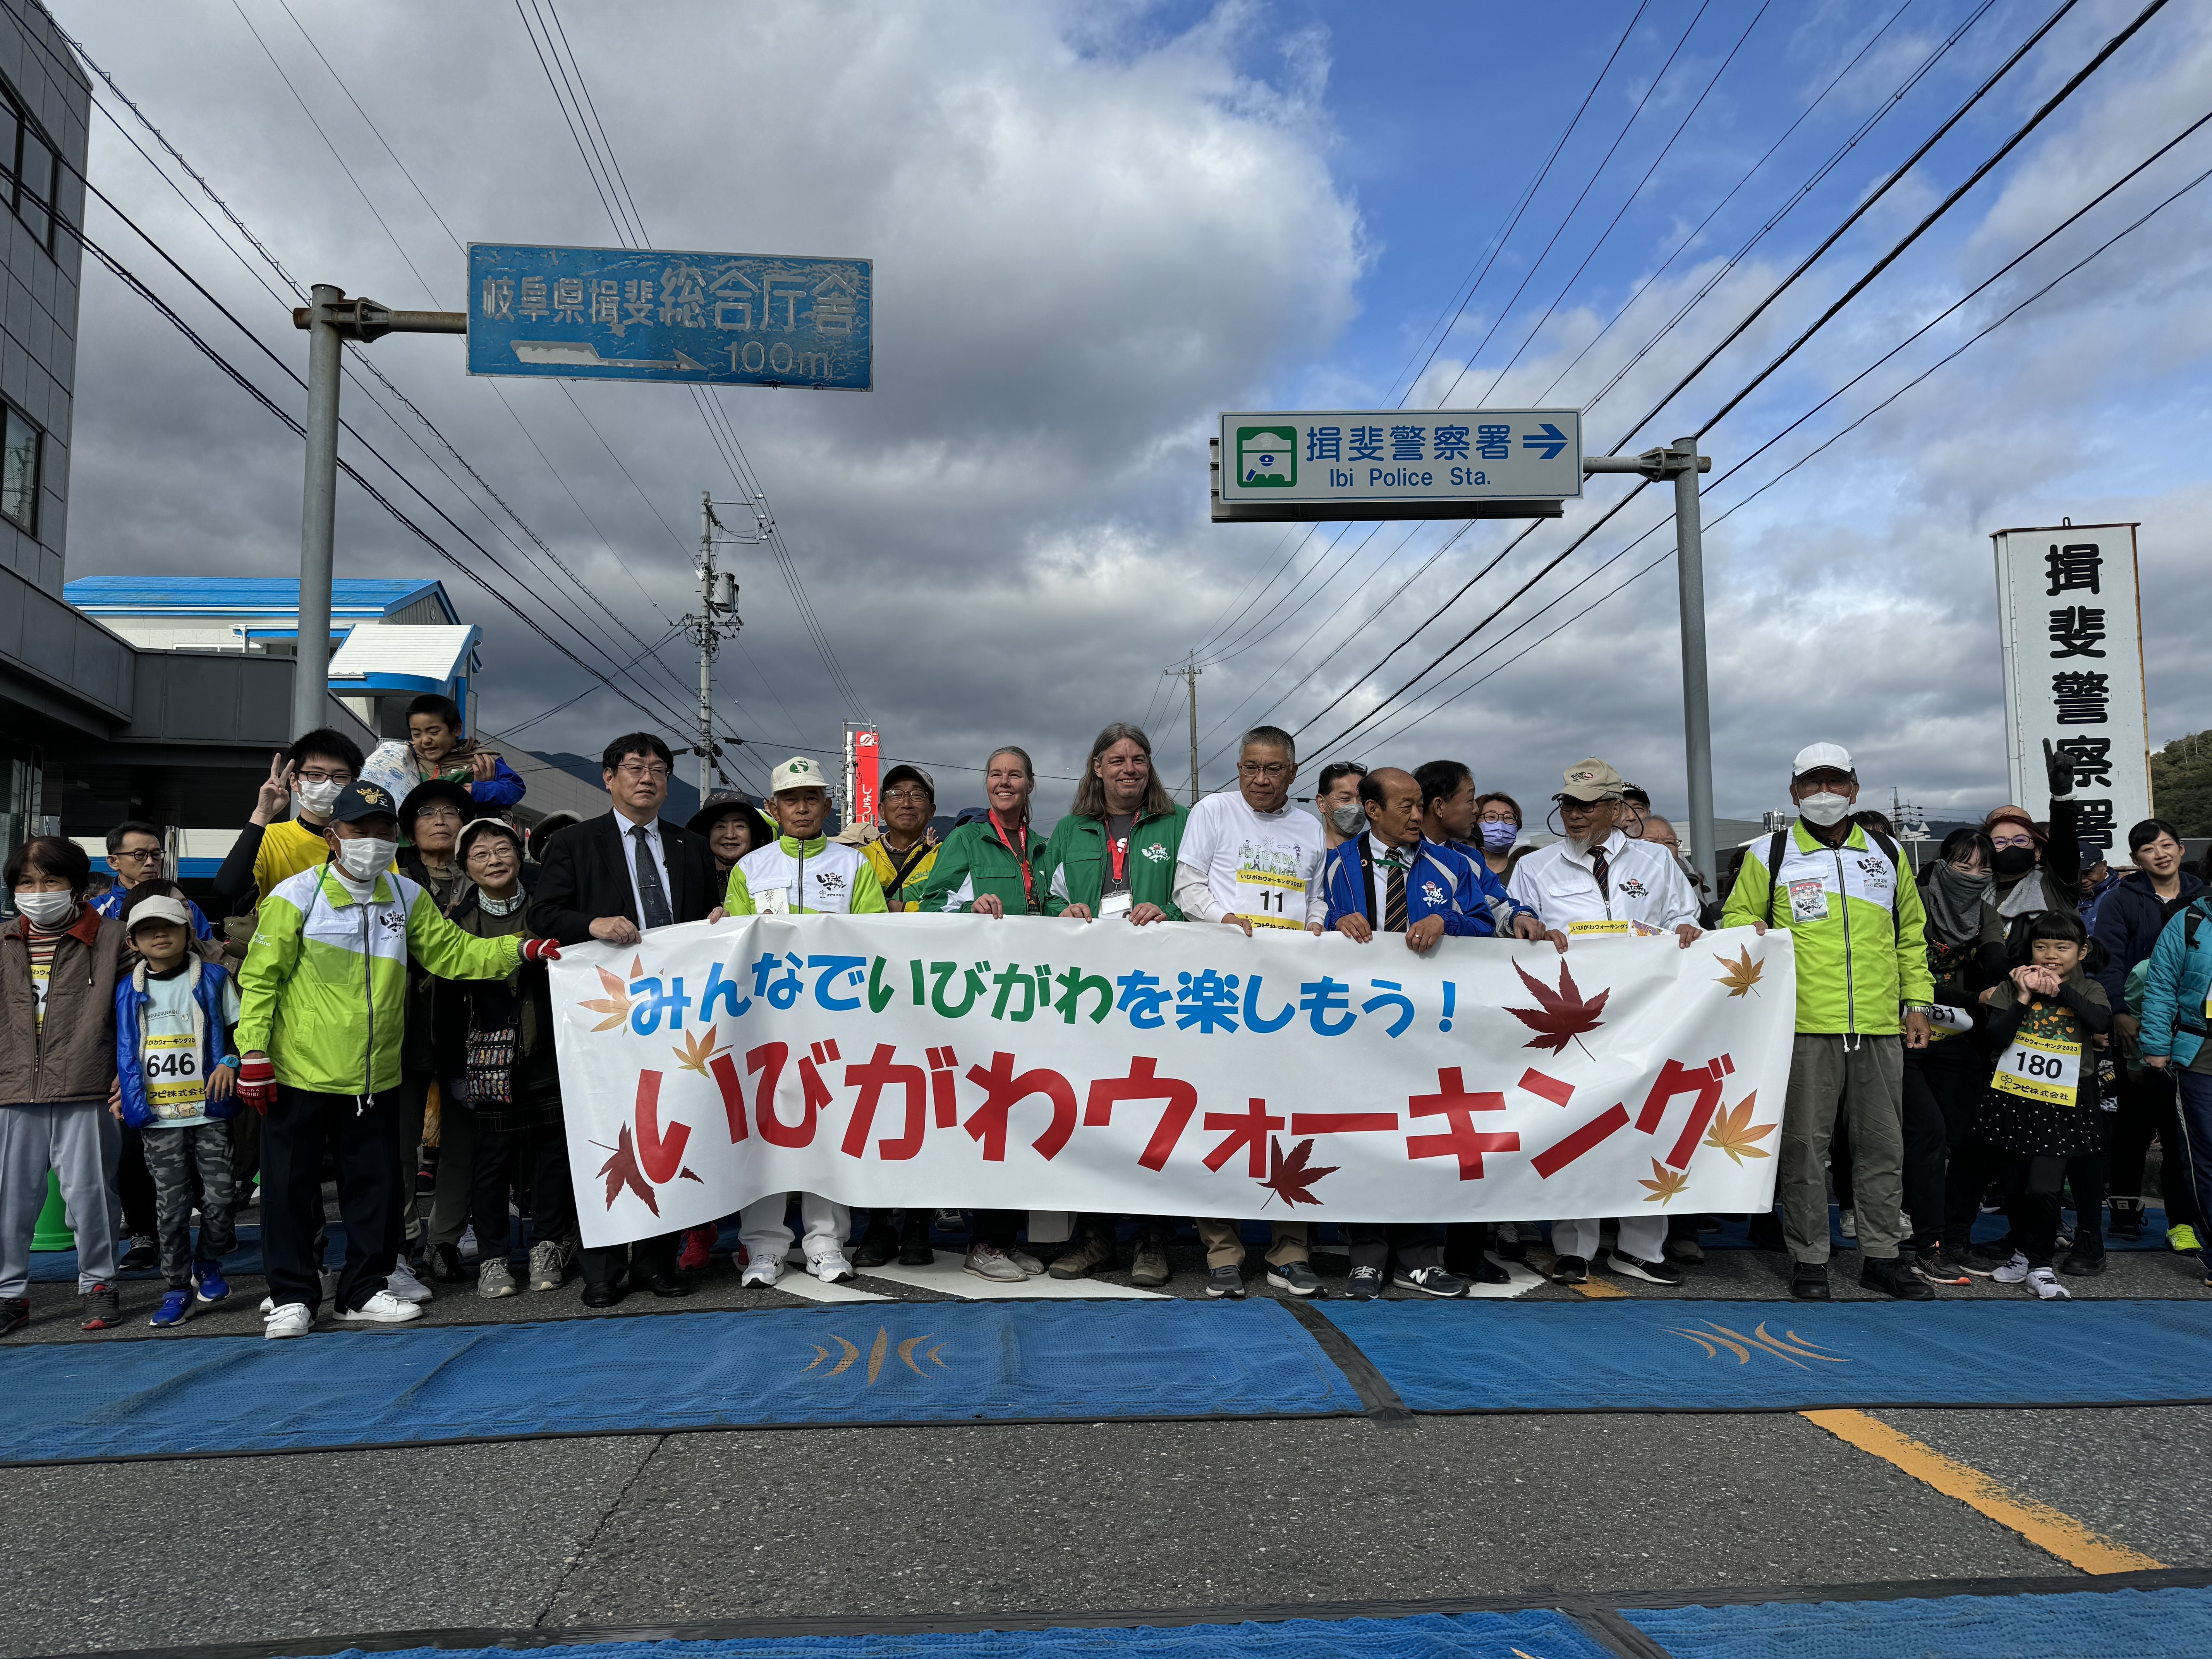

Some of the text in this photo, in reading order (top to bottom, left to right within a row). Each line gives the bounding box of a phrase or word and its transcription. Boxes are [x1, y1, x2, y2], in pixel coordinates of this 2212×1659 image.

[483, 267, 856, 335] 岐阜県揖斐総合庁舎
[723, 340, 829, 377] 100m
[1306, 424, 1512, 462] 揖斐警察署
[1330, 467, 1491, 487] Ibi Police Sta.
[1241, 874, 1302, 888] いびがわウォーキング2023
[1260, 890, 1283, 912] 11
[630, 952, 1456, 1038] みんなでいびがわを楽しもう！
[1927, 1006, 1955, 1024] 81
[2016, 1034, 2078, 1052] びがわウォーキング2023
[146, 1053, 195, 1078] 646
[2016, 1051, 2063, 1079] 180
[149, 1087, 206, 1099] アピ株式会社
[2013, 1083, 2069, 1100] アピ株式会社
[635, 1037, 1736, 1184] いびがわウォーキング
